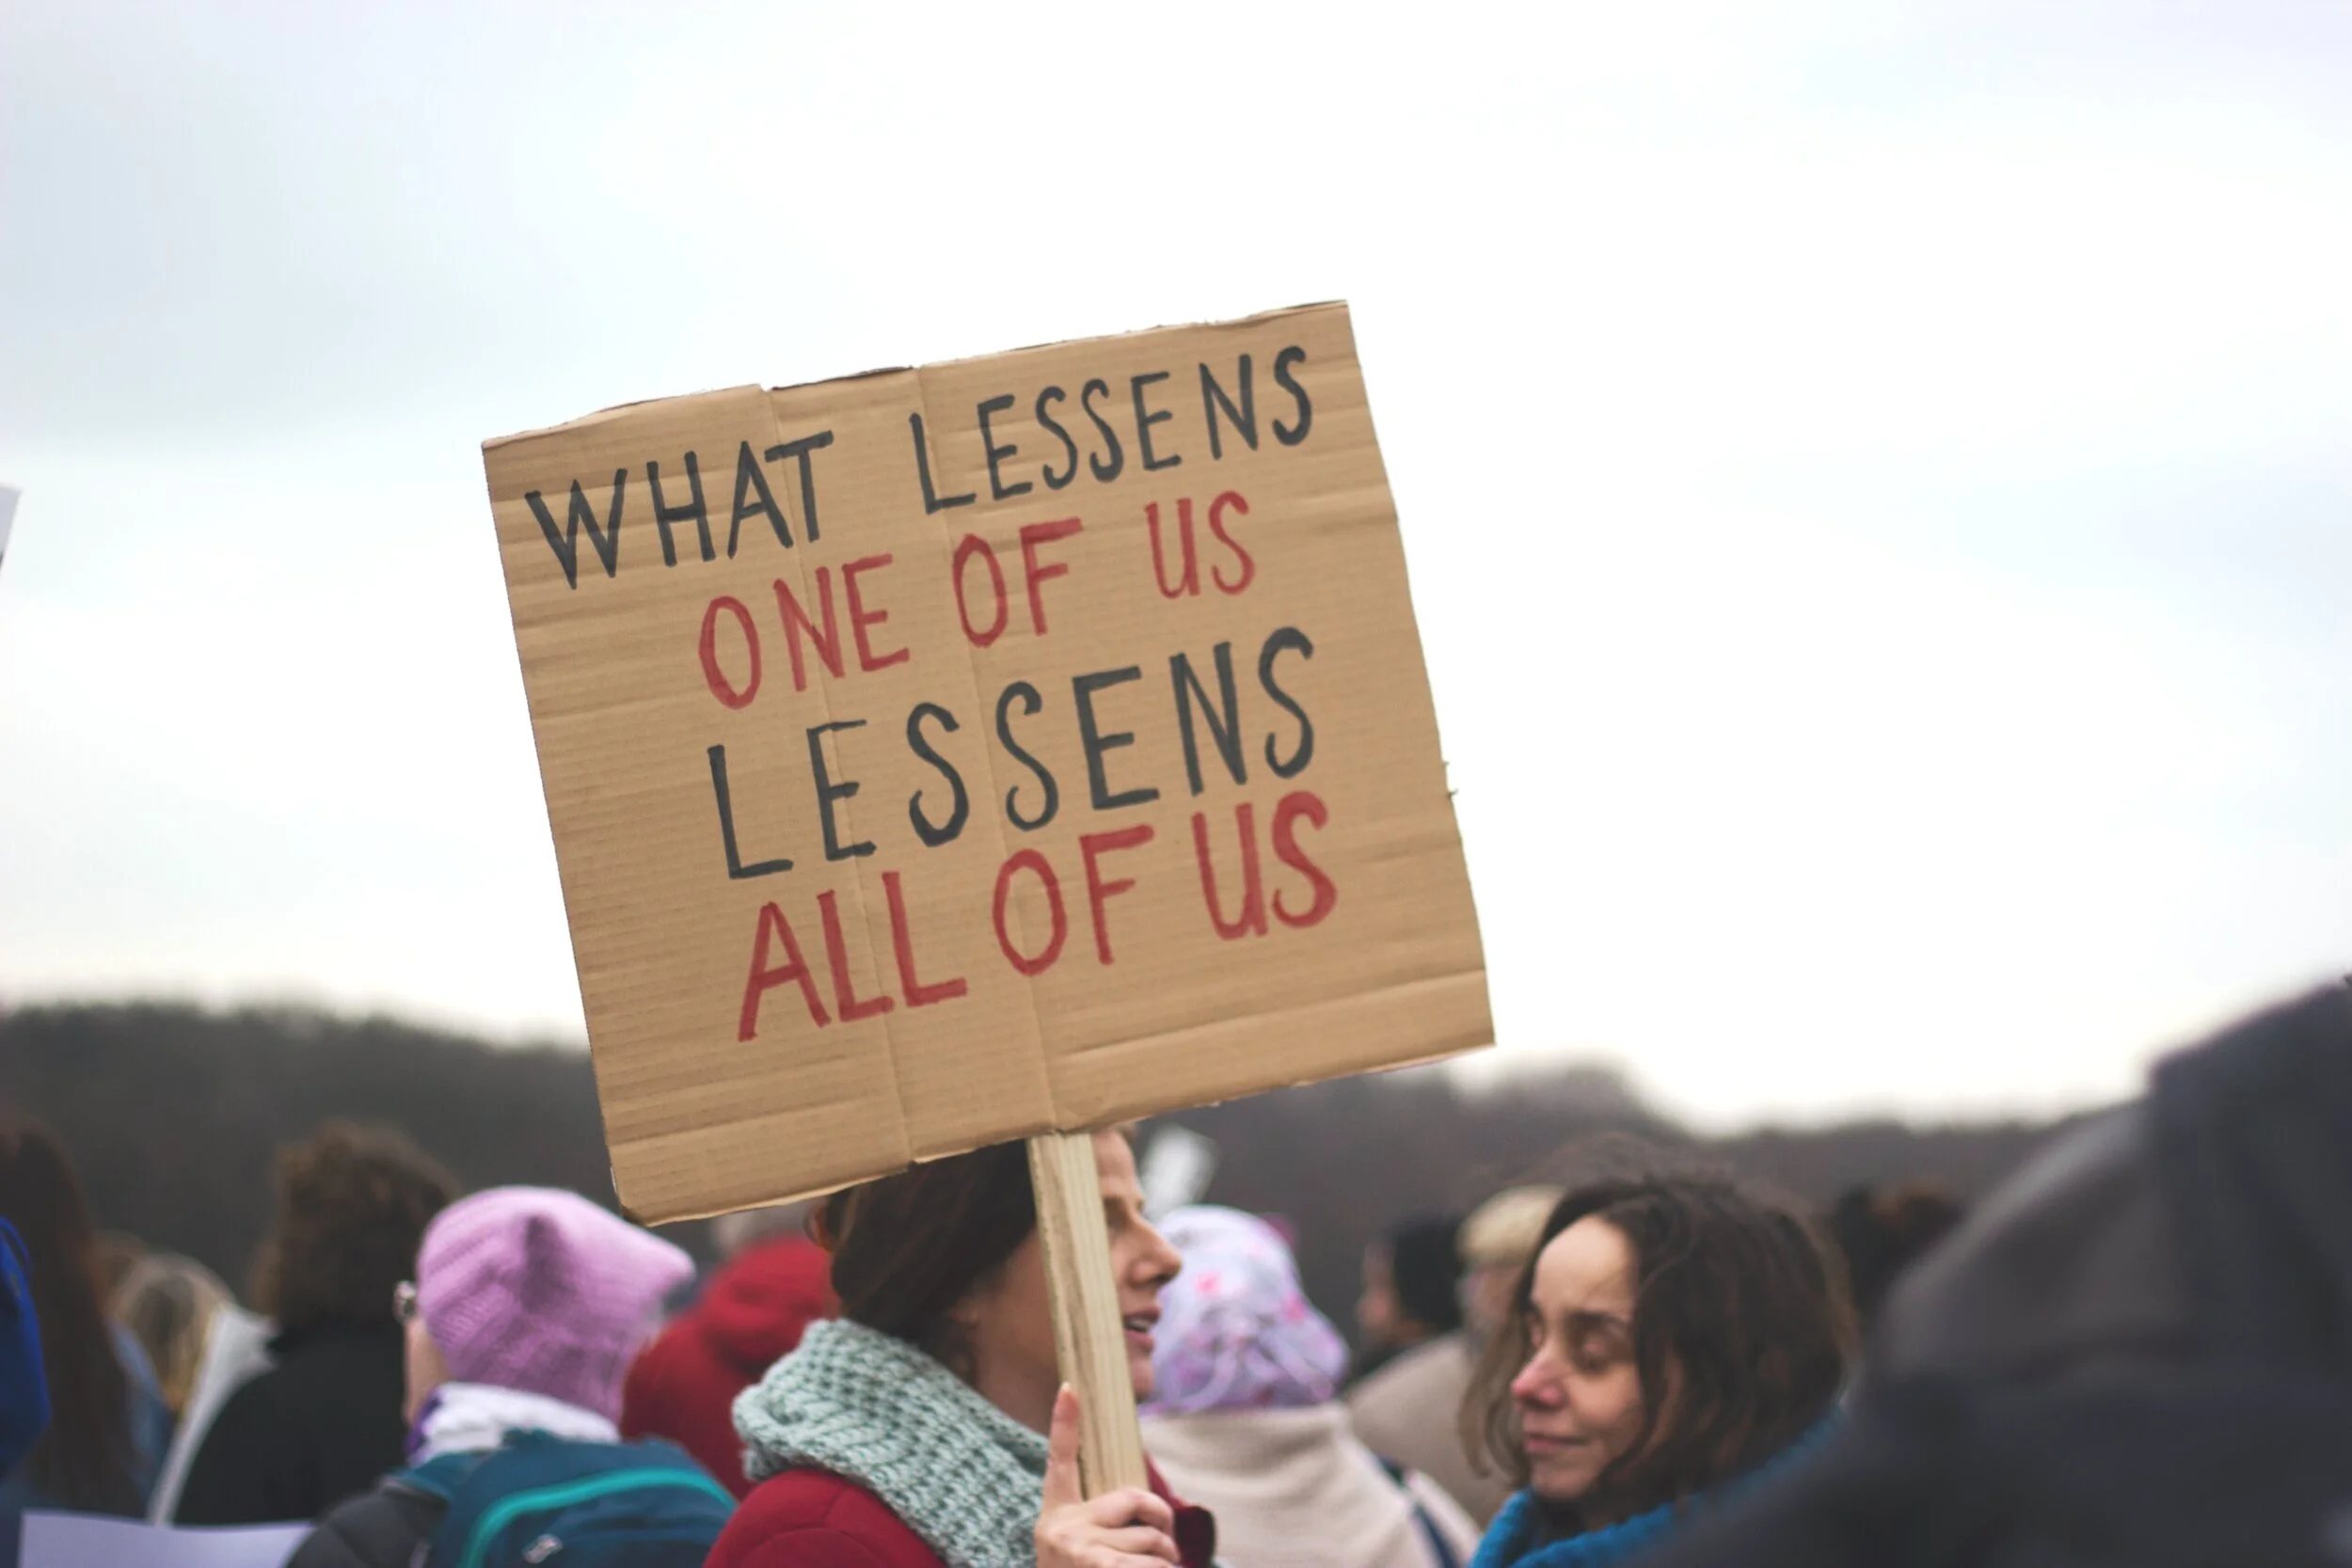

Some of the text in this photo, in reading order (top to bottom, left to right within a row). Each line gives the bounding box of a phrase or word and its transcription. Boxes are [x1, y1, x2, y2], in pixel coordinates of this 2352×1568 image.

[524, 344, 1312, 591] WHAT LESSENS
[699, 491, 1253, 707] ONE OF US
[707, 626, 1314, 879] LESSENS
[740, 791, 1336, 1040] ALL OF US
